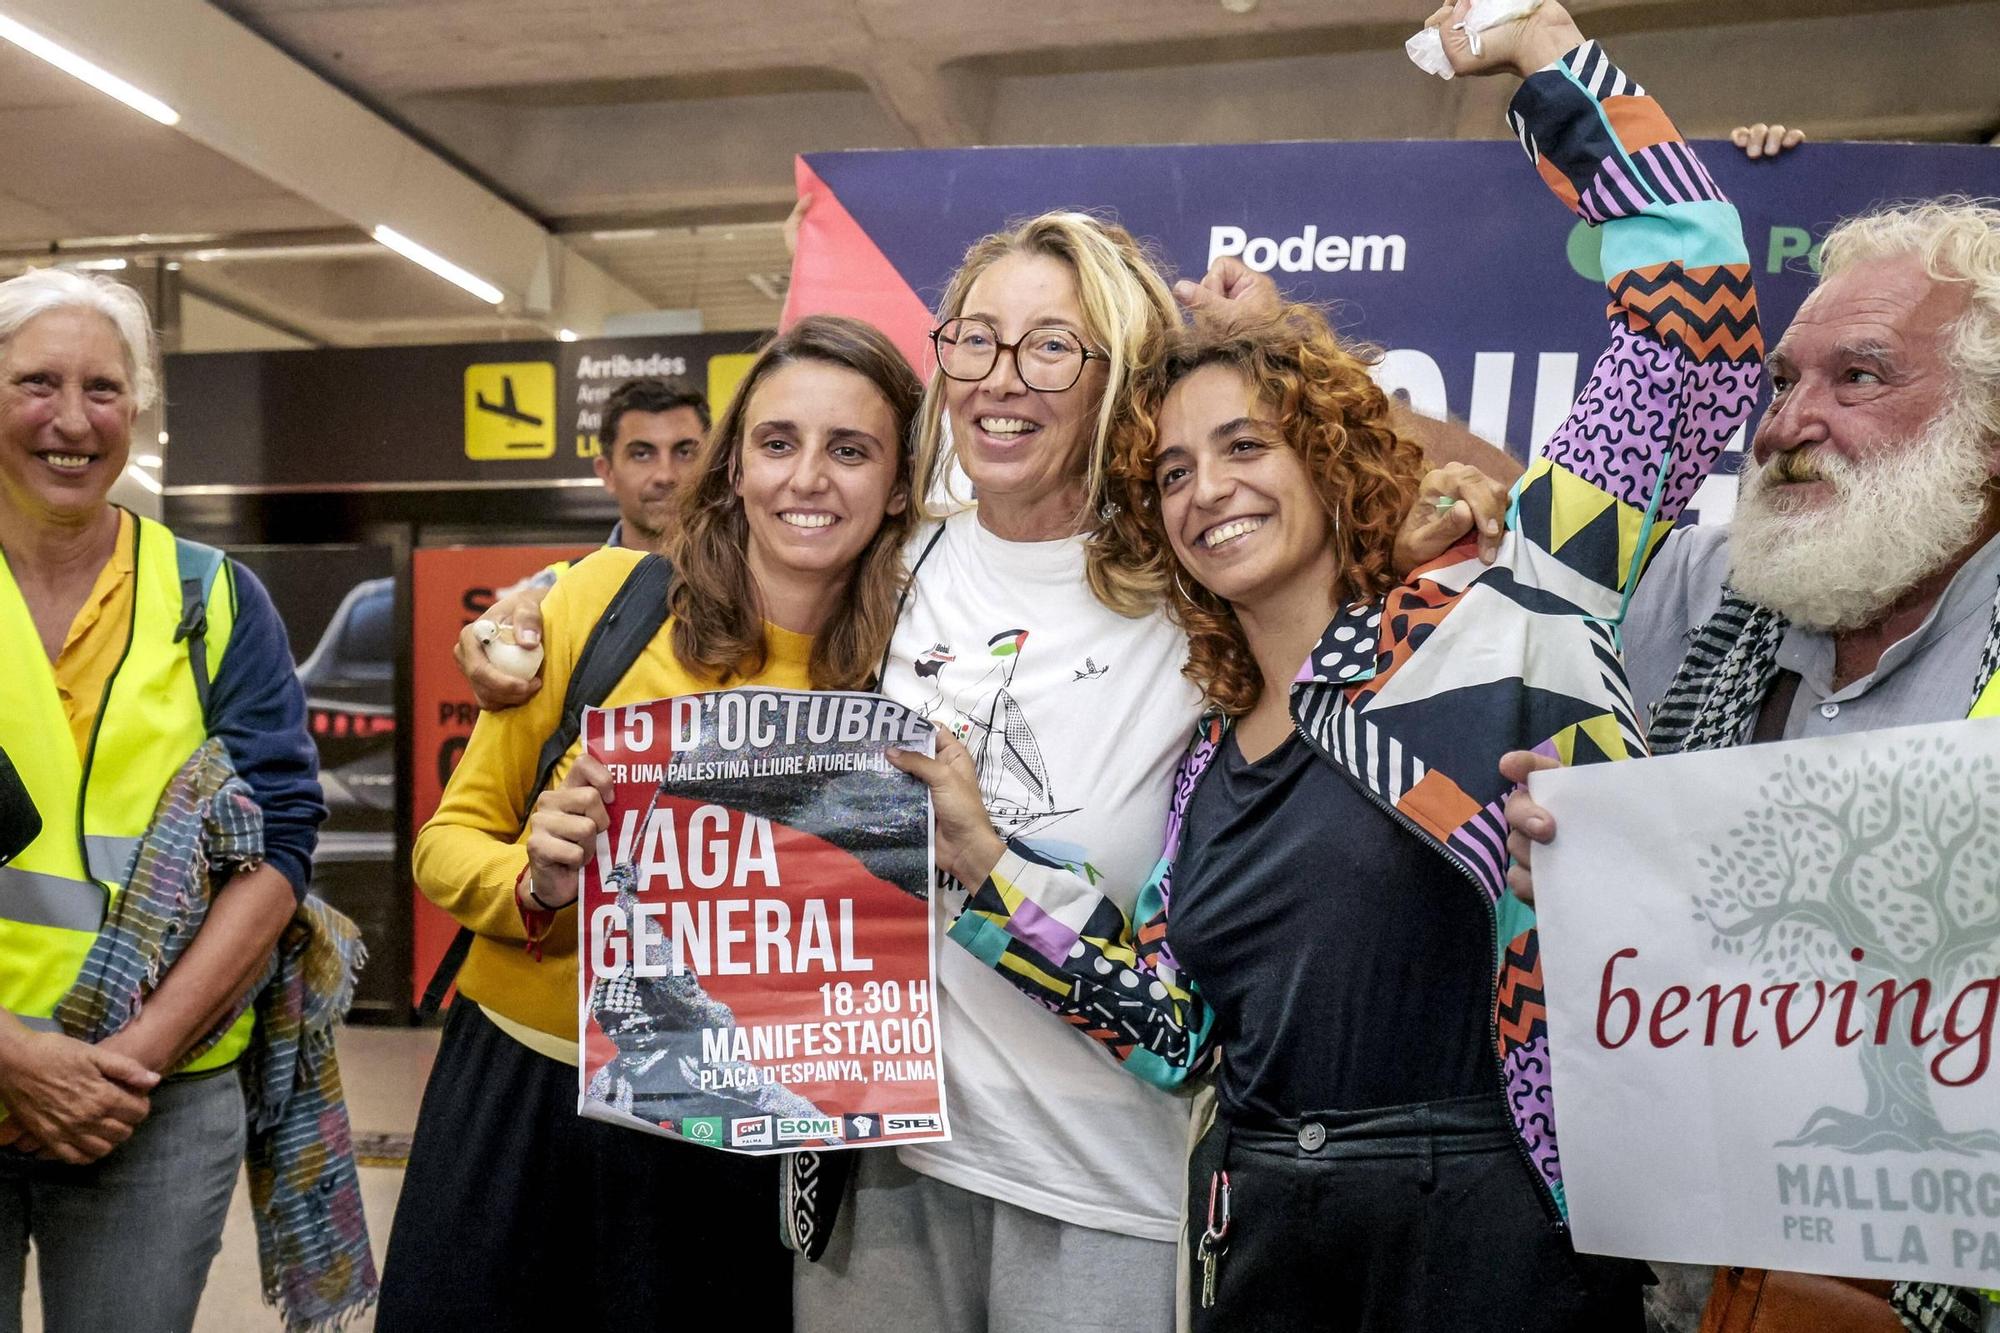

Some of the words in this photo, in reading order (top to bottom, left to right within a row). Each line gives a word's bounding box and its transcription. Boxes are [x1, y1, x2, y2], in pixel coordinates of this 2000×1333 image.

[1207, 225, 1406, 272] Podem
[577, 353, 686, 379] Arribades
[598, 702, 654, 752] 15
[671, 693, 929, 752] D'OCTUBRE
[604, 764, 628, 784] ER
[631, 763, 664, 783] UNA
[668, 758, 749, 782] PALESTINA
[753, 756, 802, 777] LLIURE
[596, 805, 780, 893] VAGA
[591, 898, 873, 979] GENERAL
[819, 981, 900, 1017] 18.30
[910, 980, 929, 1013] H
[1596, 947, 2000, 1087] benving
[702, 1012, 934, 1064] MANIFESTACIÓ
[700, 1067, 757, 1092] PLAÇA
[763, 1060, 869, 1085] D'ESPANYA,
[873, 1060, 936, 1081] PALMA
[740, 1123, 762, 1134] CNT
[780, 1120, 830, 1133] SOM
[1777, 1163, 2000, 1218] MALLORC
[1783, 1215, 1835, 1244] PER
[1861, 1223, 1929, 1265] LA
[1953, 1228, 2000, 1271] PA
